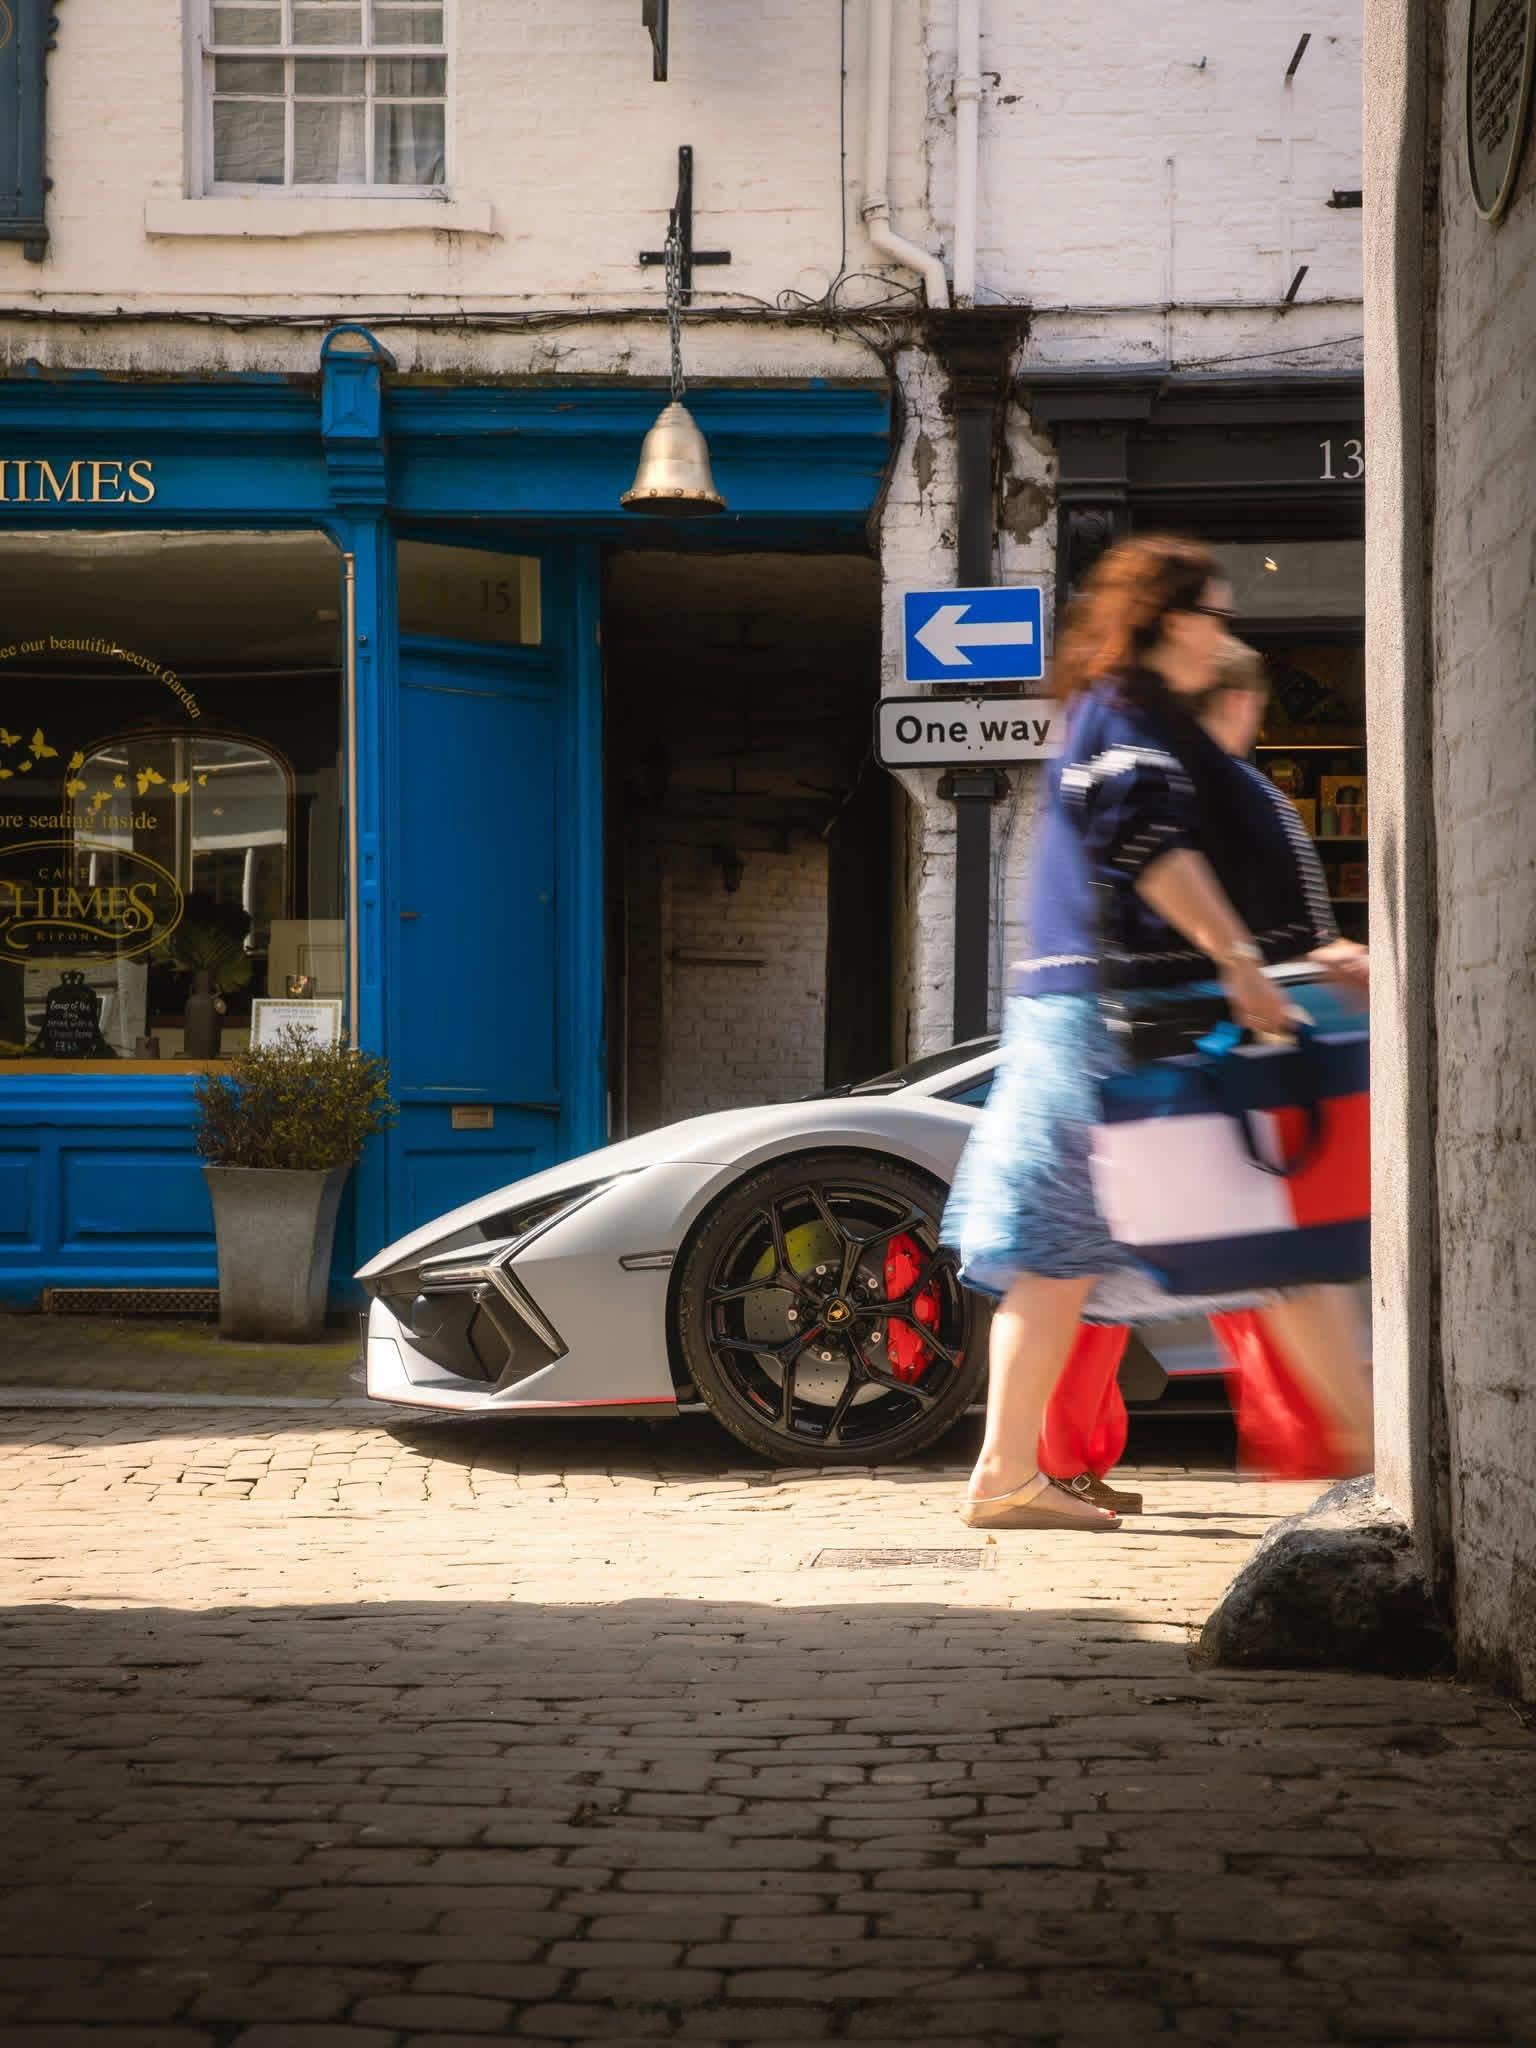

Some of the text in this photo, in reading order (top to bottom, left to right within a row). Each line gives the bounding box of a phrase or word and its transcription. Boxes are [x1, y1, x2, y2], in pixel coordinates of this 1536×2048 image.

[1320, 439, 1364, 479] 13
[0, 460, 155, 503] IMES
[0, 634, 201, 719] ee our beautiful secret Garden
[895, 715, 1051, 746] One way
[29, 810, 95, 830] seating
[103, 812, 158, 830] inside
[38, 868, 89, 880] CAE
